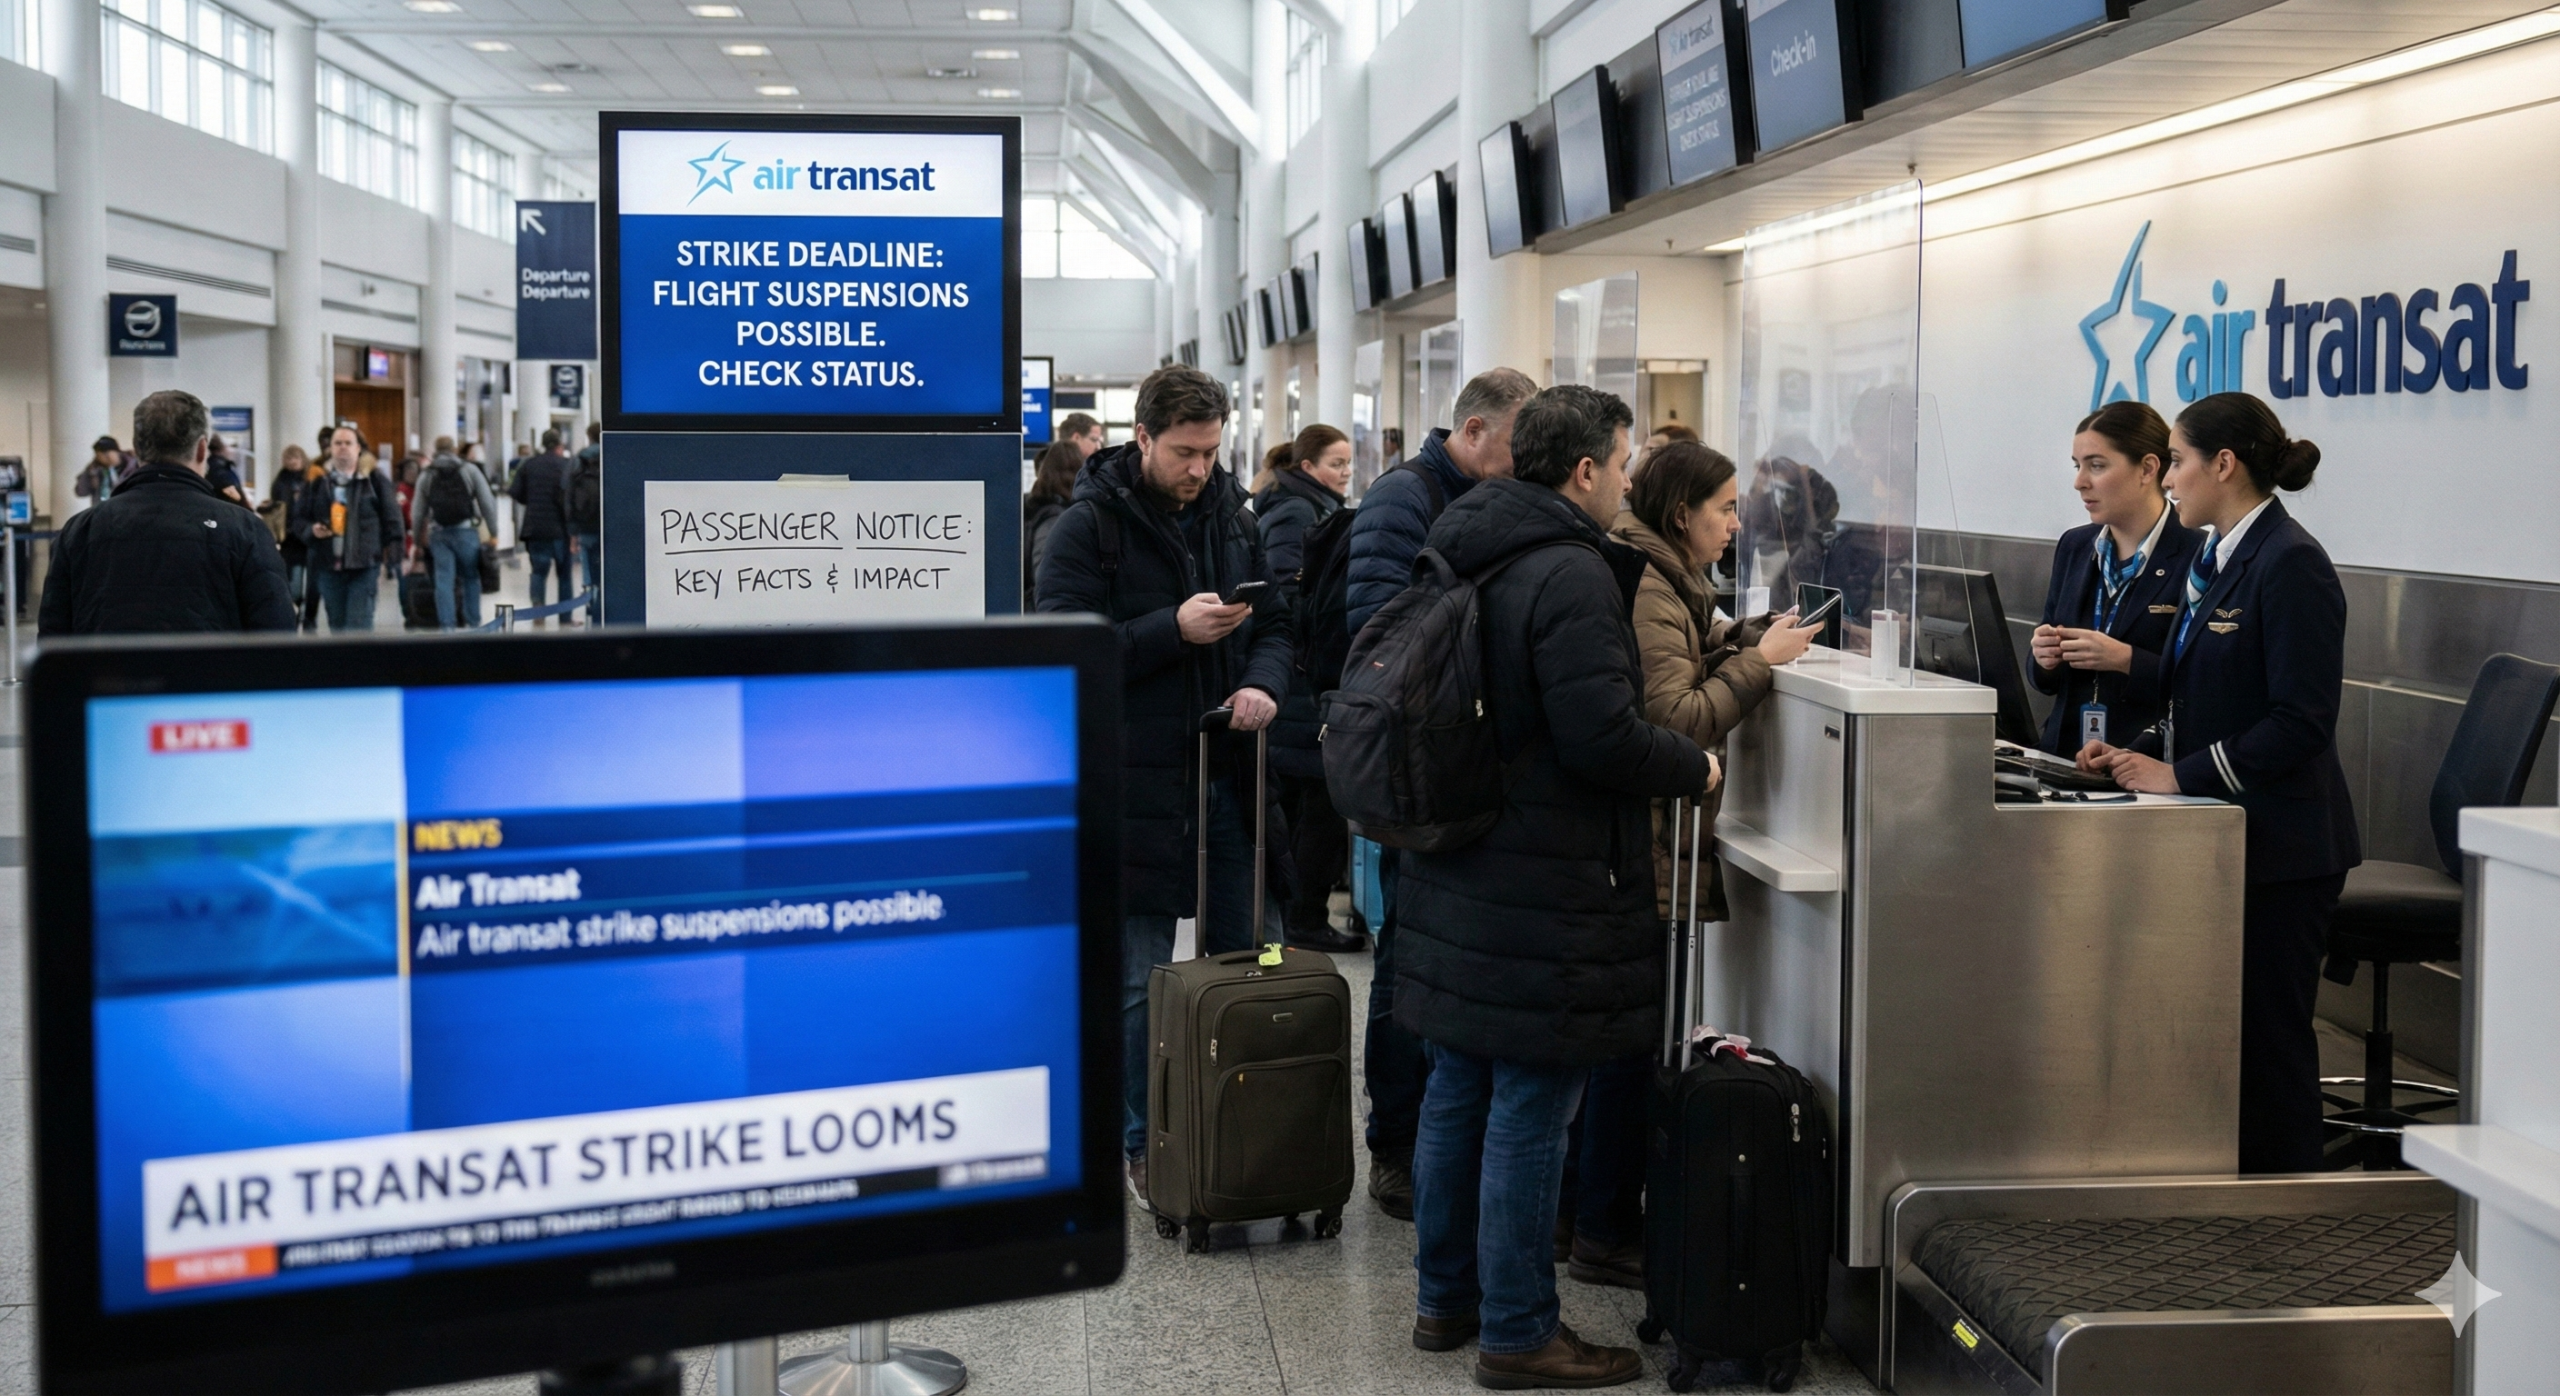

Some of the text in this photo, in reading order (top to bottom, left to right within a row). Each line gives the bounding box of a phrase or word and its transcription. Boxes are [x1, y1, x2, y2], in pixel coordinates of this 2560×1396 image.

[1770, 30, 1817, 77] Check-in
[753, 158, 936, 192] air transat
[676, 240, 944, 268] STRIKE DEADLINE:
[521, 267, 591, 285] Departure
[521, 284, 591, 302] Departure
[653, 280, 970, 308] FLIGHT SUSPENSIONS
[736, 320, 886, 347] POSSIBLE.
[2176, 249, 2531, 403] air transat
[698, 360, 925, 388] CHECK STATUS.
[660, 509, 972, 544] PASSENGER NOTICE:
[674, 563, 951, 599] KEY FACTS & IMPACT
[163, 722, 233, 752] LIVE
[414, 817, 503, 851] NEWS
[416, 867, 581, 910] Air Transat
[416, 923, 464, 958] Air
[468, 916, 571, 956] transat
[576, 909, 657, 947] strike
[661, 899, 829, 943] suspensions
[171, 1099, 957, 1230] AIR TRANSAT STRIKE LOOMS
